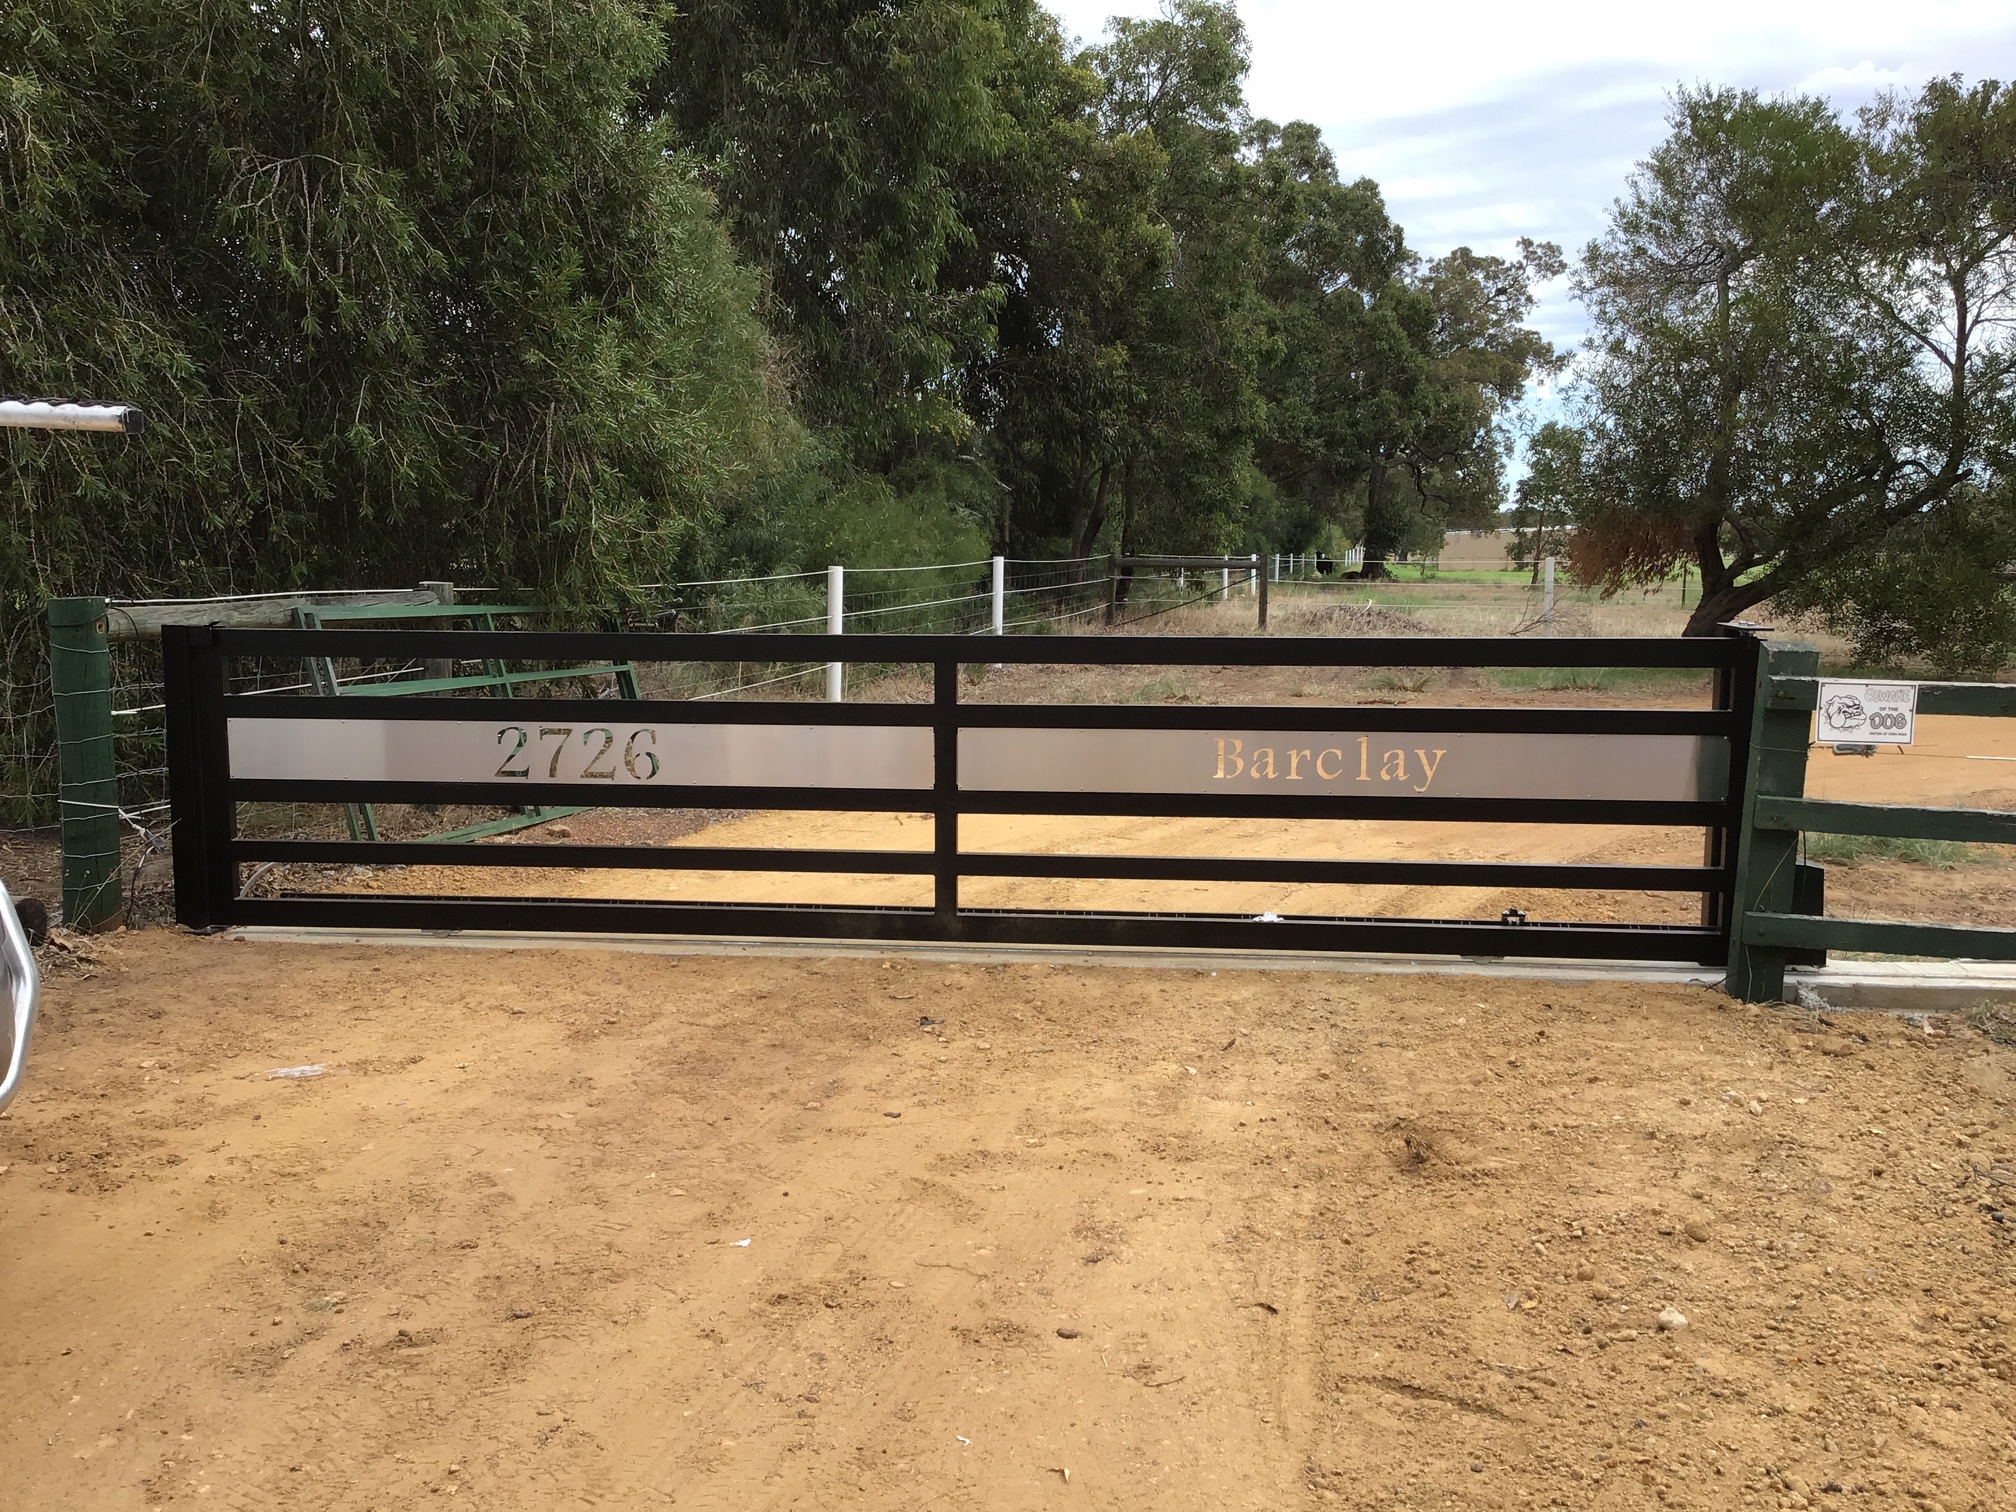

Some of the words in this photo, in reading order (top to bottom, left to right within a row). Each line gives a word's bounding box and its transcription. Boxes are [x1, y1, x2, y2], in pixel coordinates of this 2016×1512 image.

[1869, 712, 1907, 730] DOG
[494, 726, 660, 781] 2726
[1212, 736, 1447, 793] Barclay
